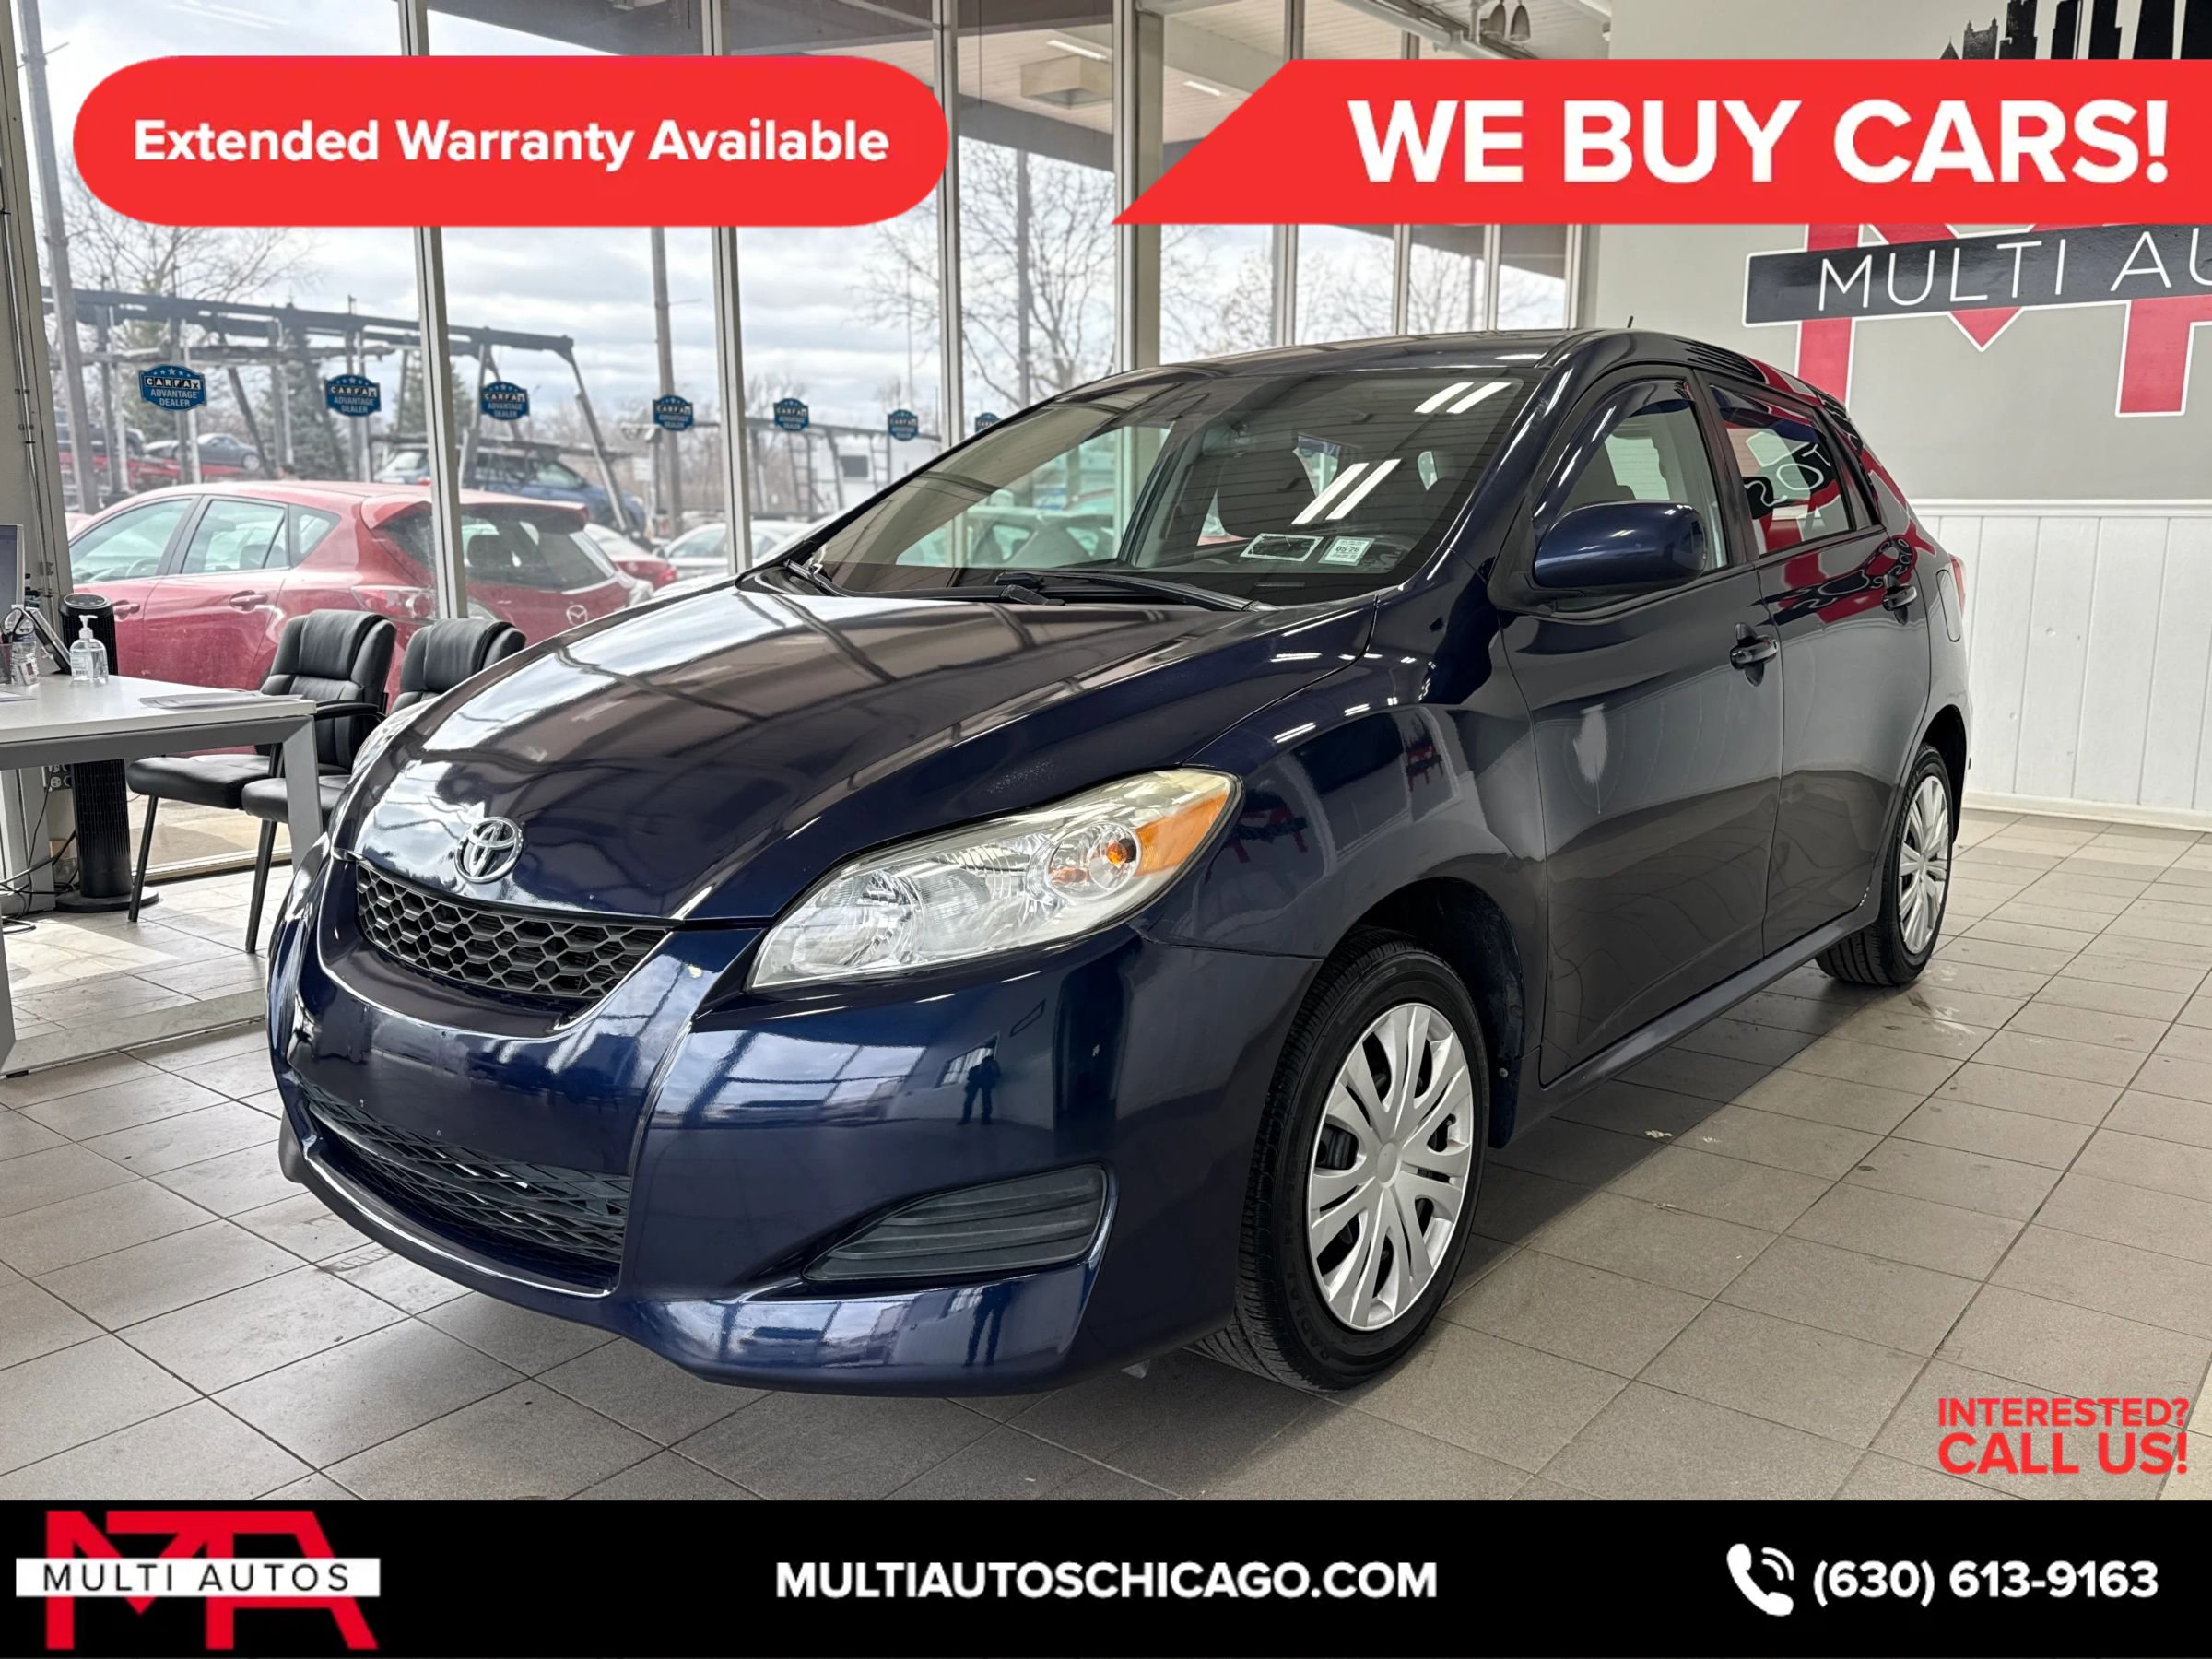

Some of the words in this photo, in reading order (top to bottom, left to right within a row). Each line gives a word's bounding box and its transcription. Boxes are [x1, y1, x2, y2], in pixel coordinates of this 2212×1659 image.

[1818, 238, 2066, 312] MULTI
[146, 377, 200, 390] CARFAX
[150, 388, 198, 398] ADVANTAGE
[159, 398, 191, 406] DEALER
